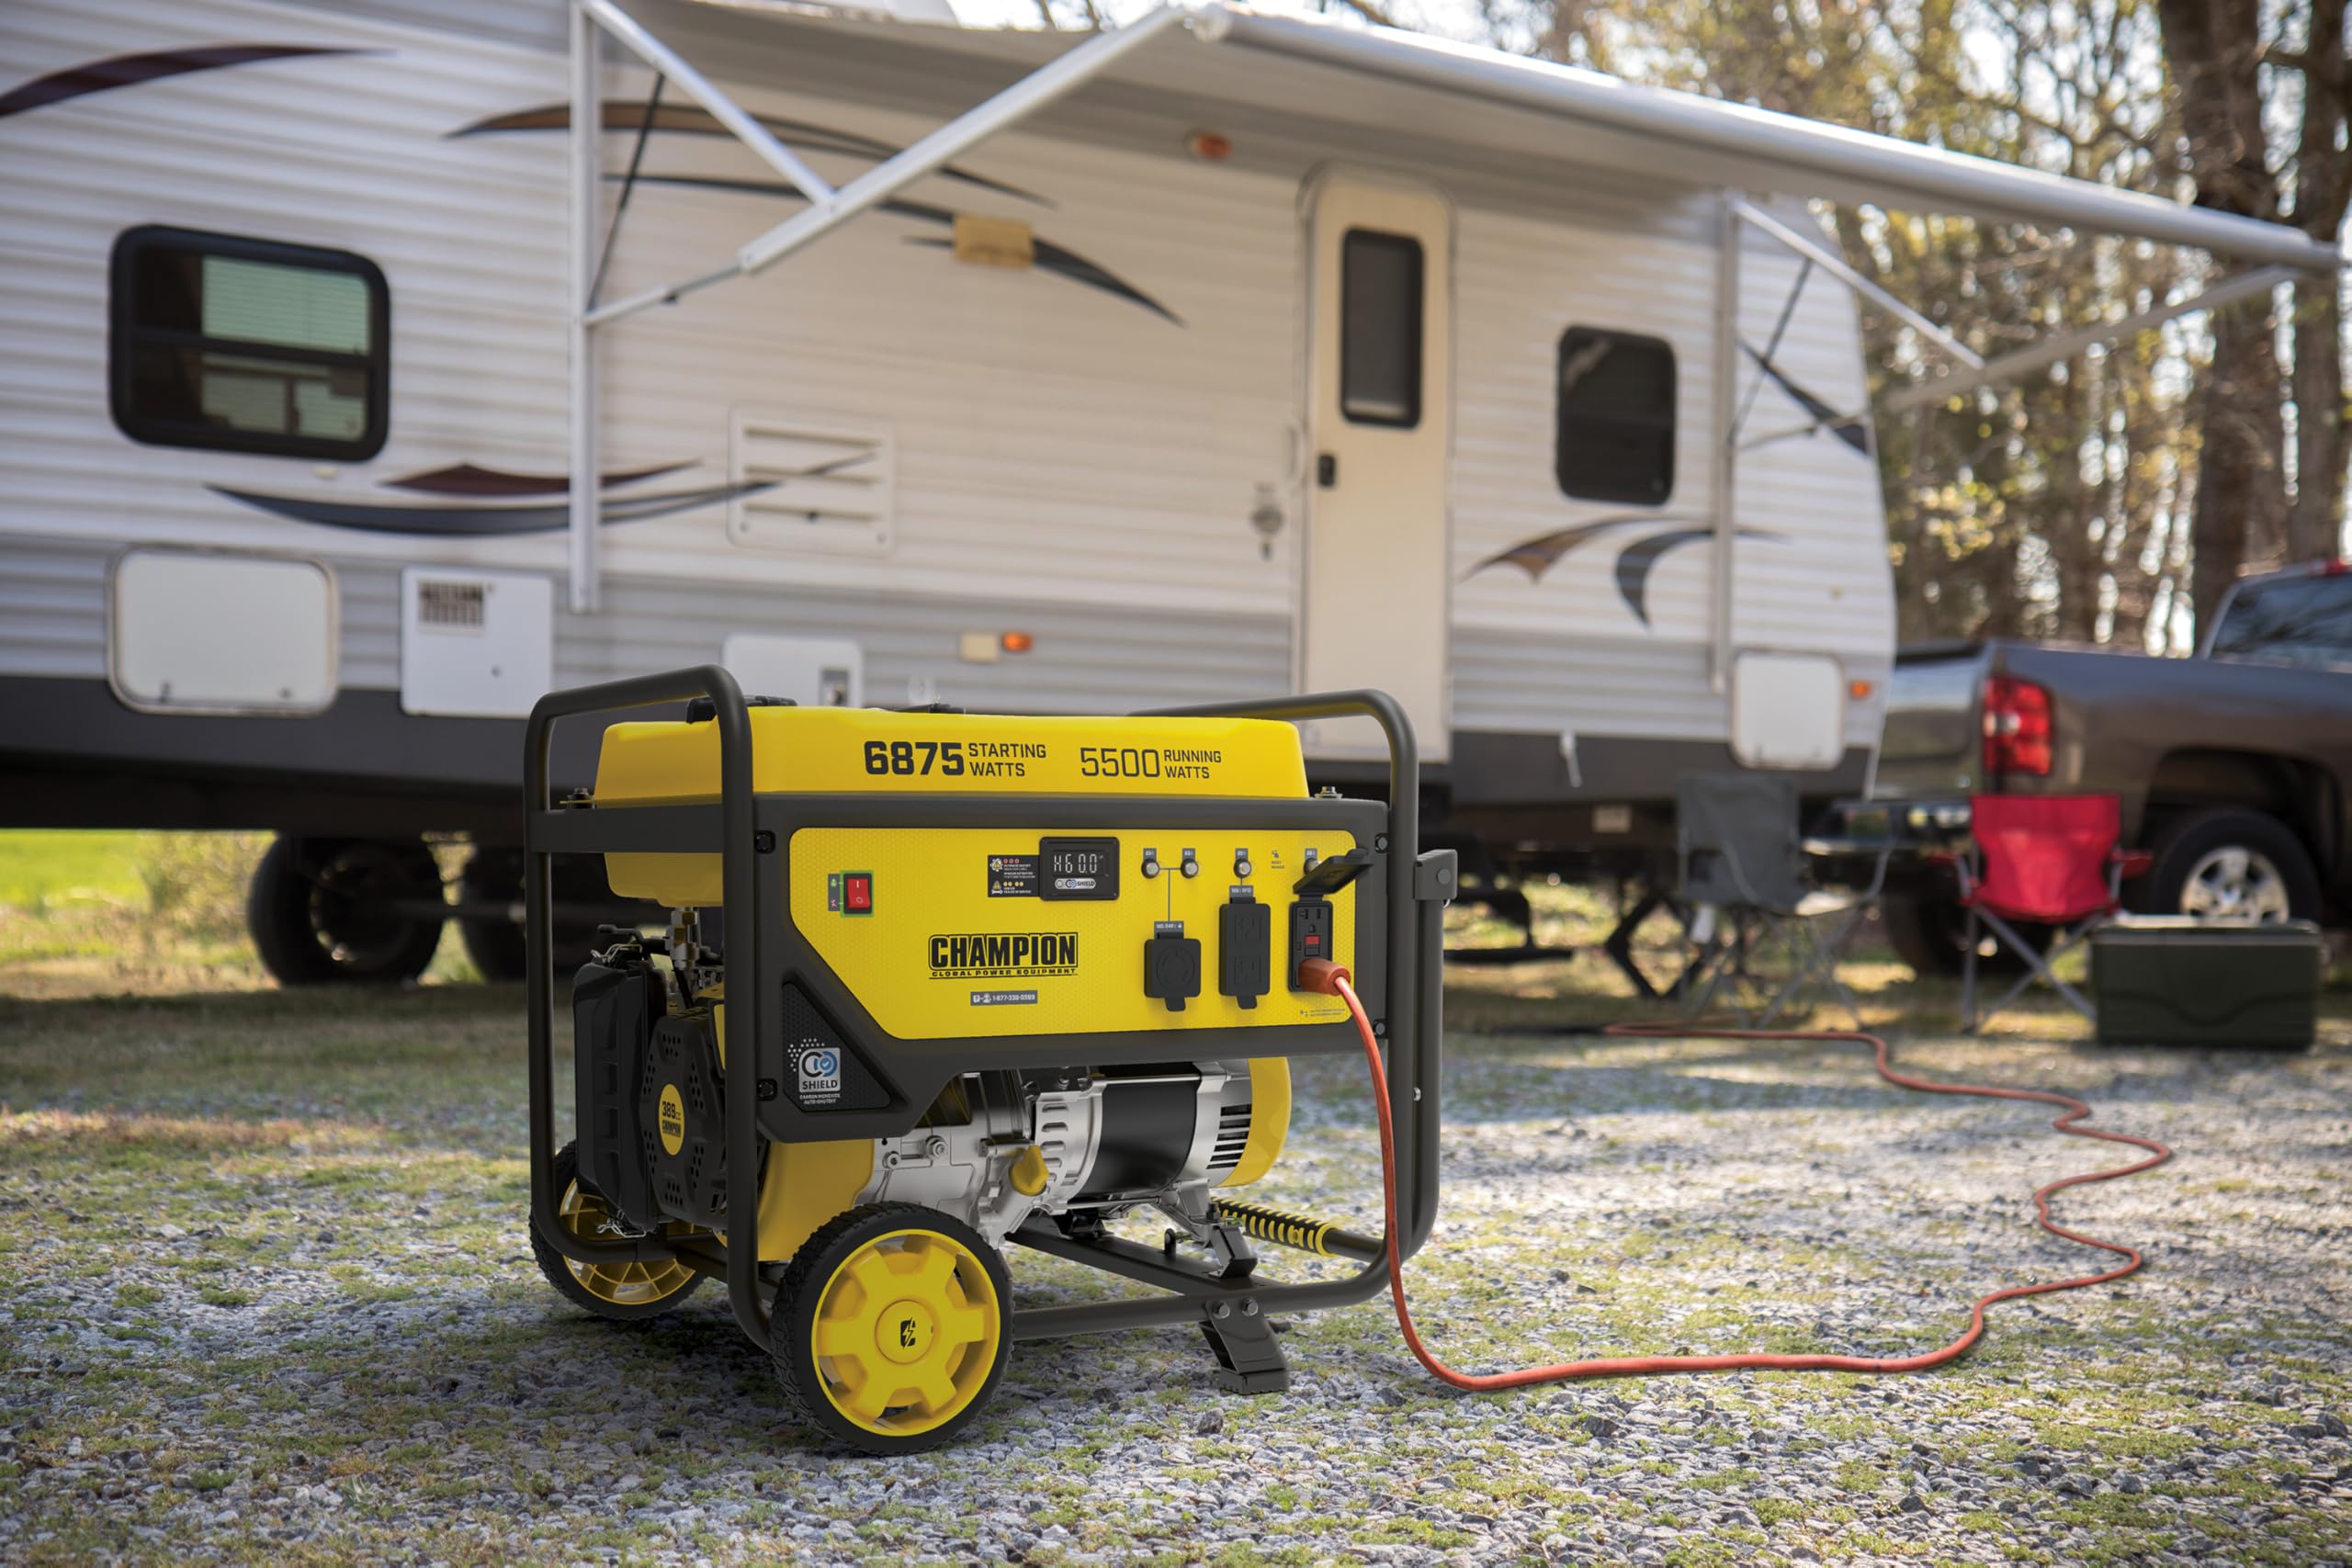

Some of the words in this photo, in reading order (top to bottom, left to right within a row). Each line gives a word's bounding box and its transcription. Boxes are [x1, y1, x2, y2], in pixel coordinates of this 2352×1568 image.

[864, 740, 966, 776] 6875
[968, 742, 1046, 759] STARTING
[1164, 749, 1222, 764] RUNNING
[969, 761, 1026, 777] WATTS
[1080, 747, 1160, 778] 5500
[1164, 765, 1210, 780] WATTS
[930, 933, 1077, 969] CHAMPION
[802, 1079, 839, 1090] SHIELD
